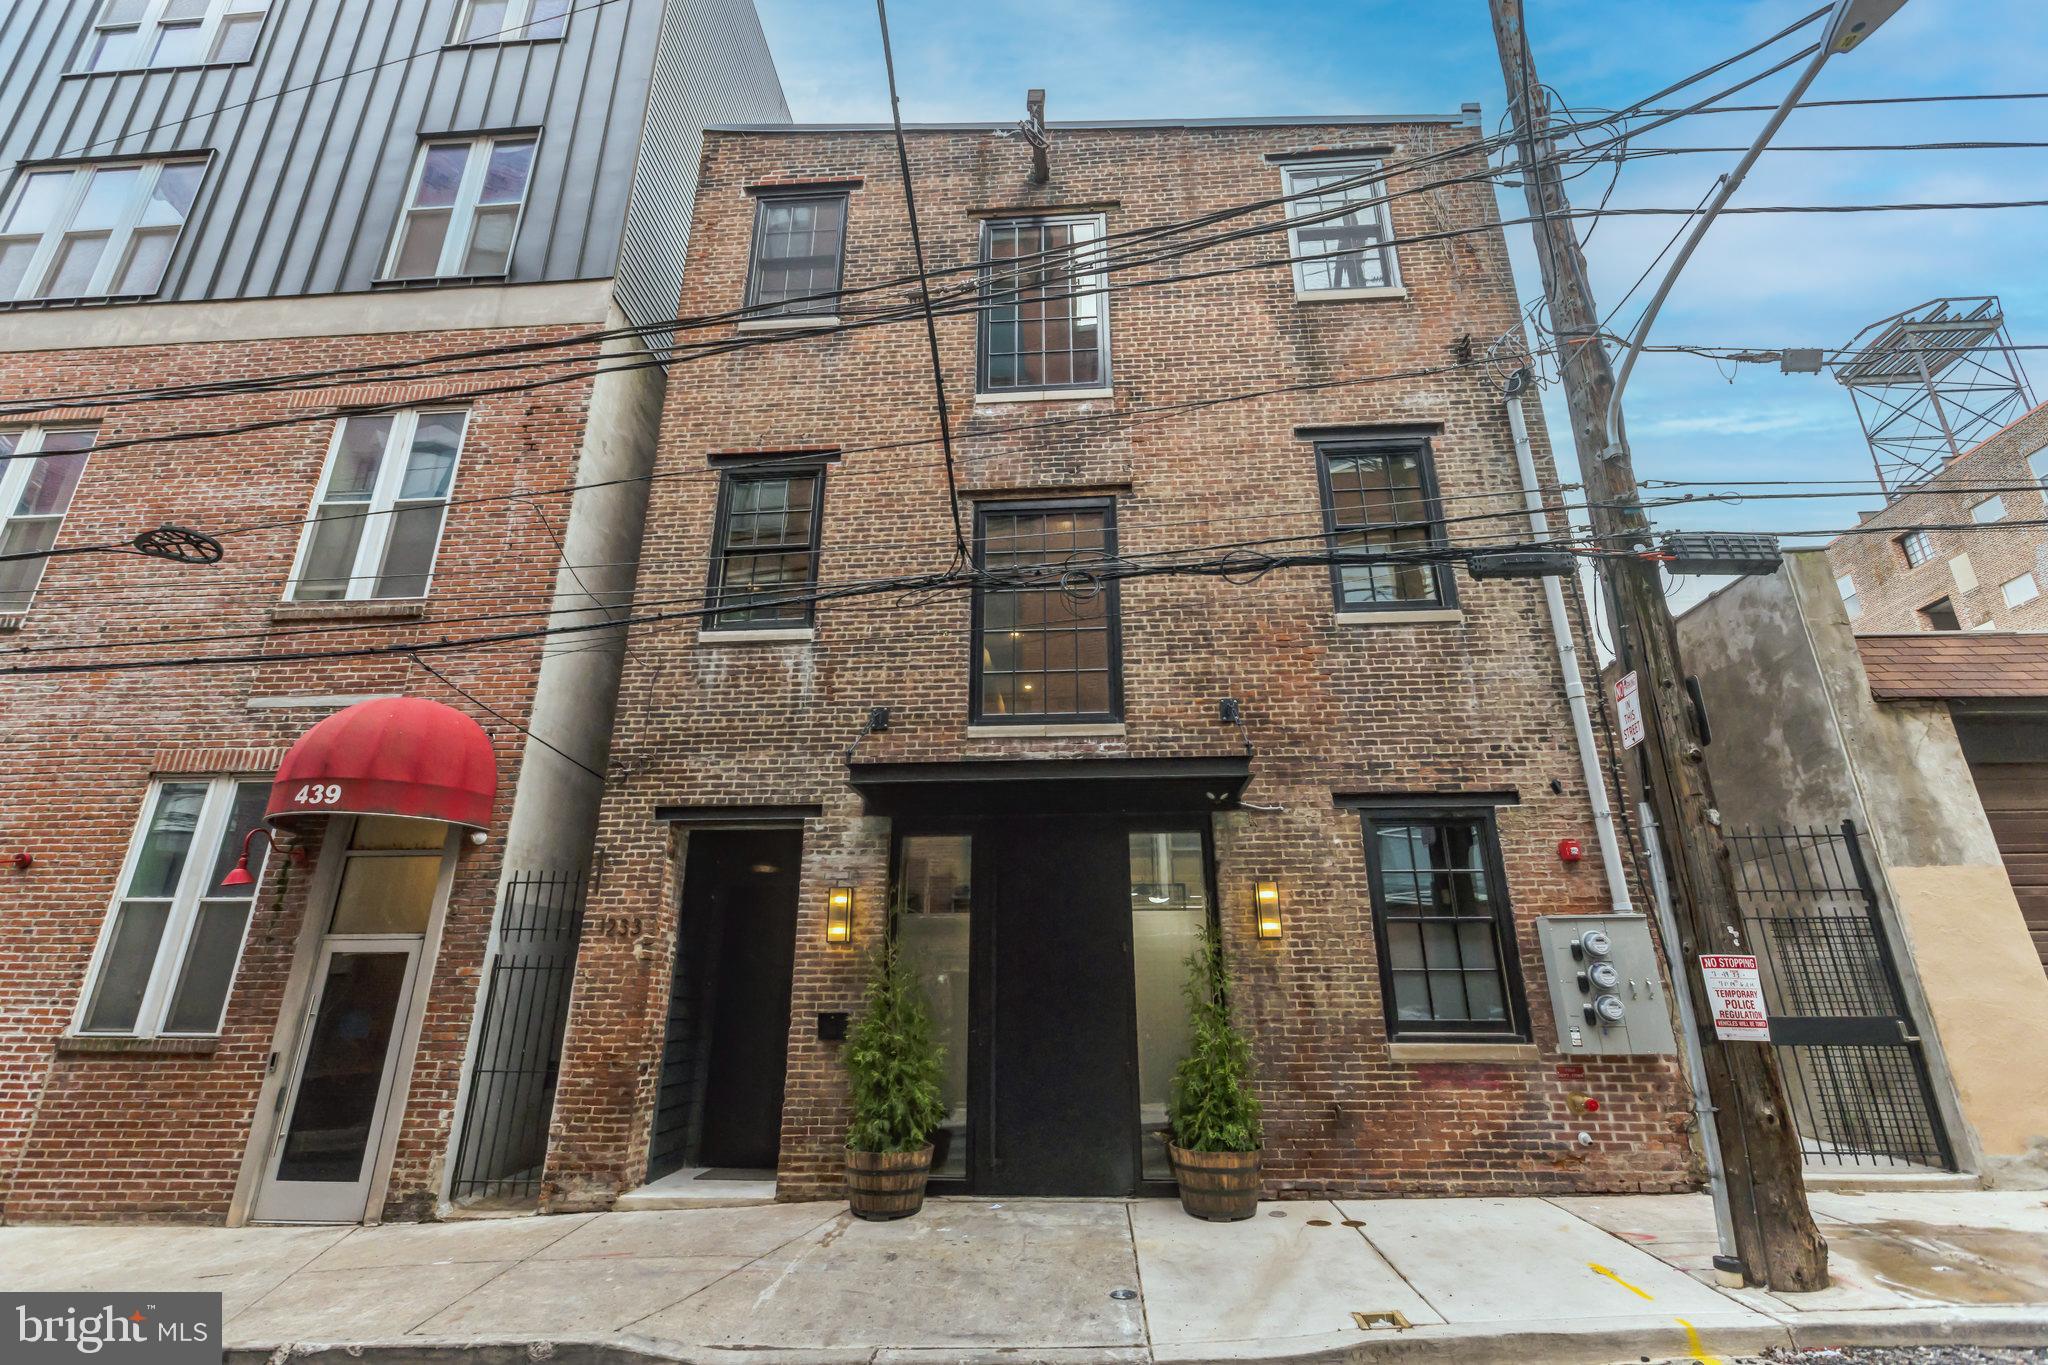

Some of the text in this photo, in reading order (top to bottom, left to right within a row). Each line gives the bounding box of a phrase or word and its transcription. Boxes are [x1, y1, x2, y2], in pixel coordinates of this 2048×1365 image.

[1624, 709, 1636, 724] THIS
[1623, 721, 1640, 740] STREET
[294, 784, 342, 804] 439
[1704, 957, 1755, 969] NO STOPPING
[1715, 989, 1758, 999] TEMPORARY
[1725, 999, 1756, 1010] POLICE
[1719, 1010, 1763, 1020] REGULATION
